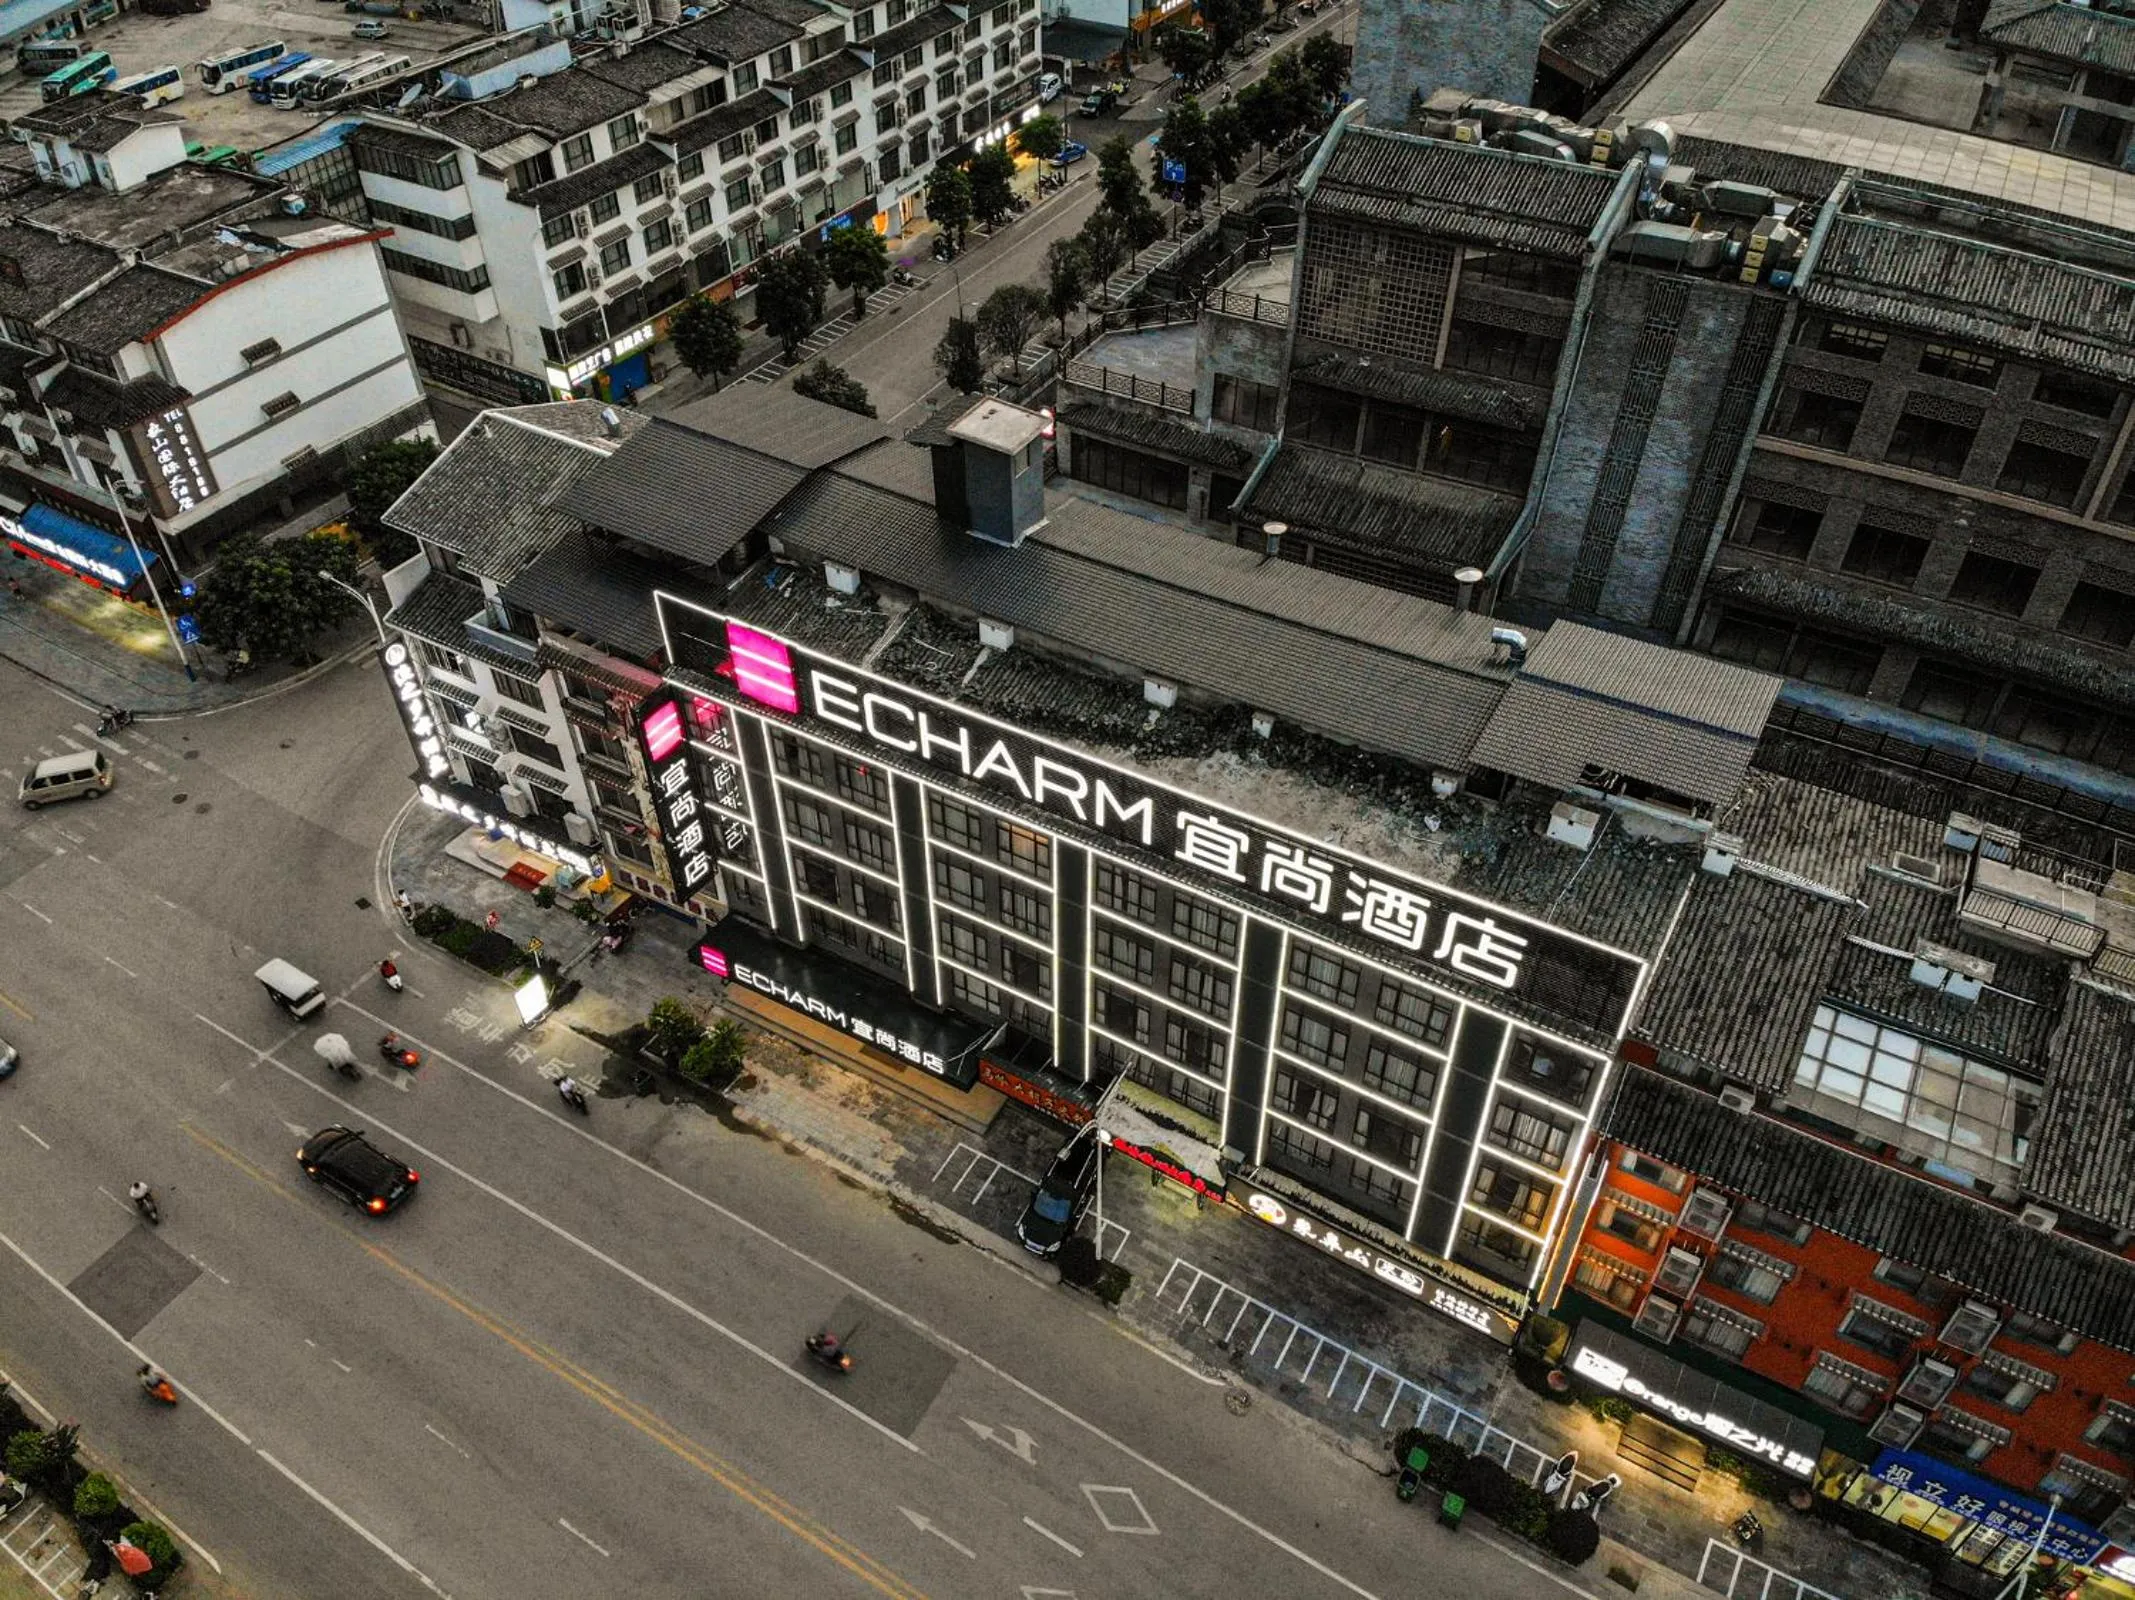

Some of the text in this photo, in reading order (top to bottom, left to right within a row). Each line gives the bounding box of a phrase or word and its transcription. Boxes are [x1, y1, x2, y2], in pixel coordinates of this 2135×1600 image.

[163, 408, 184, 422] TEL
[660, 758, 711, 888] 宜尚酒店
[810, 669, 1529, 989] ECHARM 宜尚酒店
[734, 963, 945, 1074] ECHARM 宜尚酒店
[1885, 1463, 1985, 1515] 视立好
